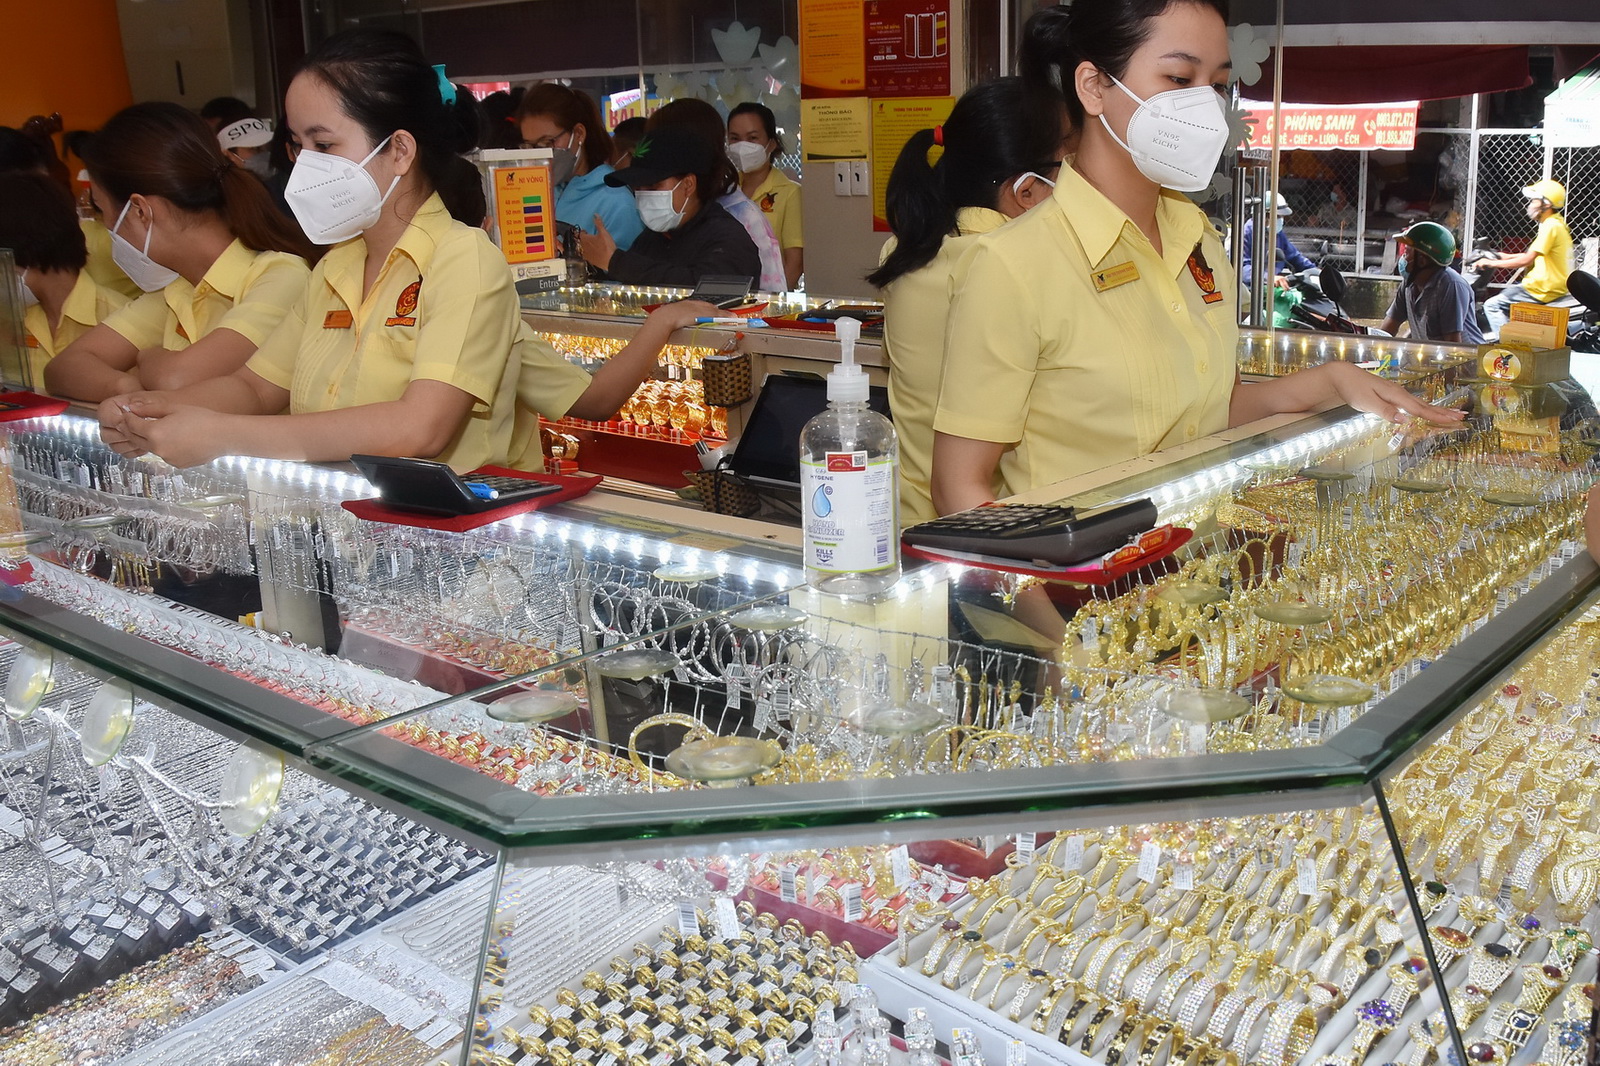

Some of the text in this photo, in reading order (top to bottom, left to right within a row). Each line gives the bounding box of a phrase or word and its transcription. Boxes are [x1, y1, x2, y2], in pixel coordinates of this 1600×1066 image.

[1284, 111, 1322, 131] PHÓNG
[1324, 114, 1356, 131] SANH
[227, 120, 268, 140] SPO
[1157, 129, 1180, 142] VN95
[1152, 137, 1179, 150] KICHY
[1293, 131, 1313, 145] CHÉP
[329, 189, 351, 201] VN95
[332, 196, 356, 209] KICHY
[539, 278, 560, 289] Entris
